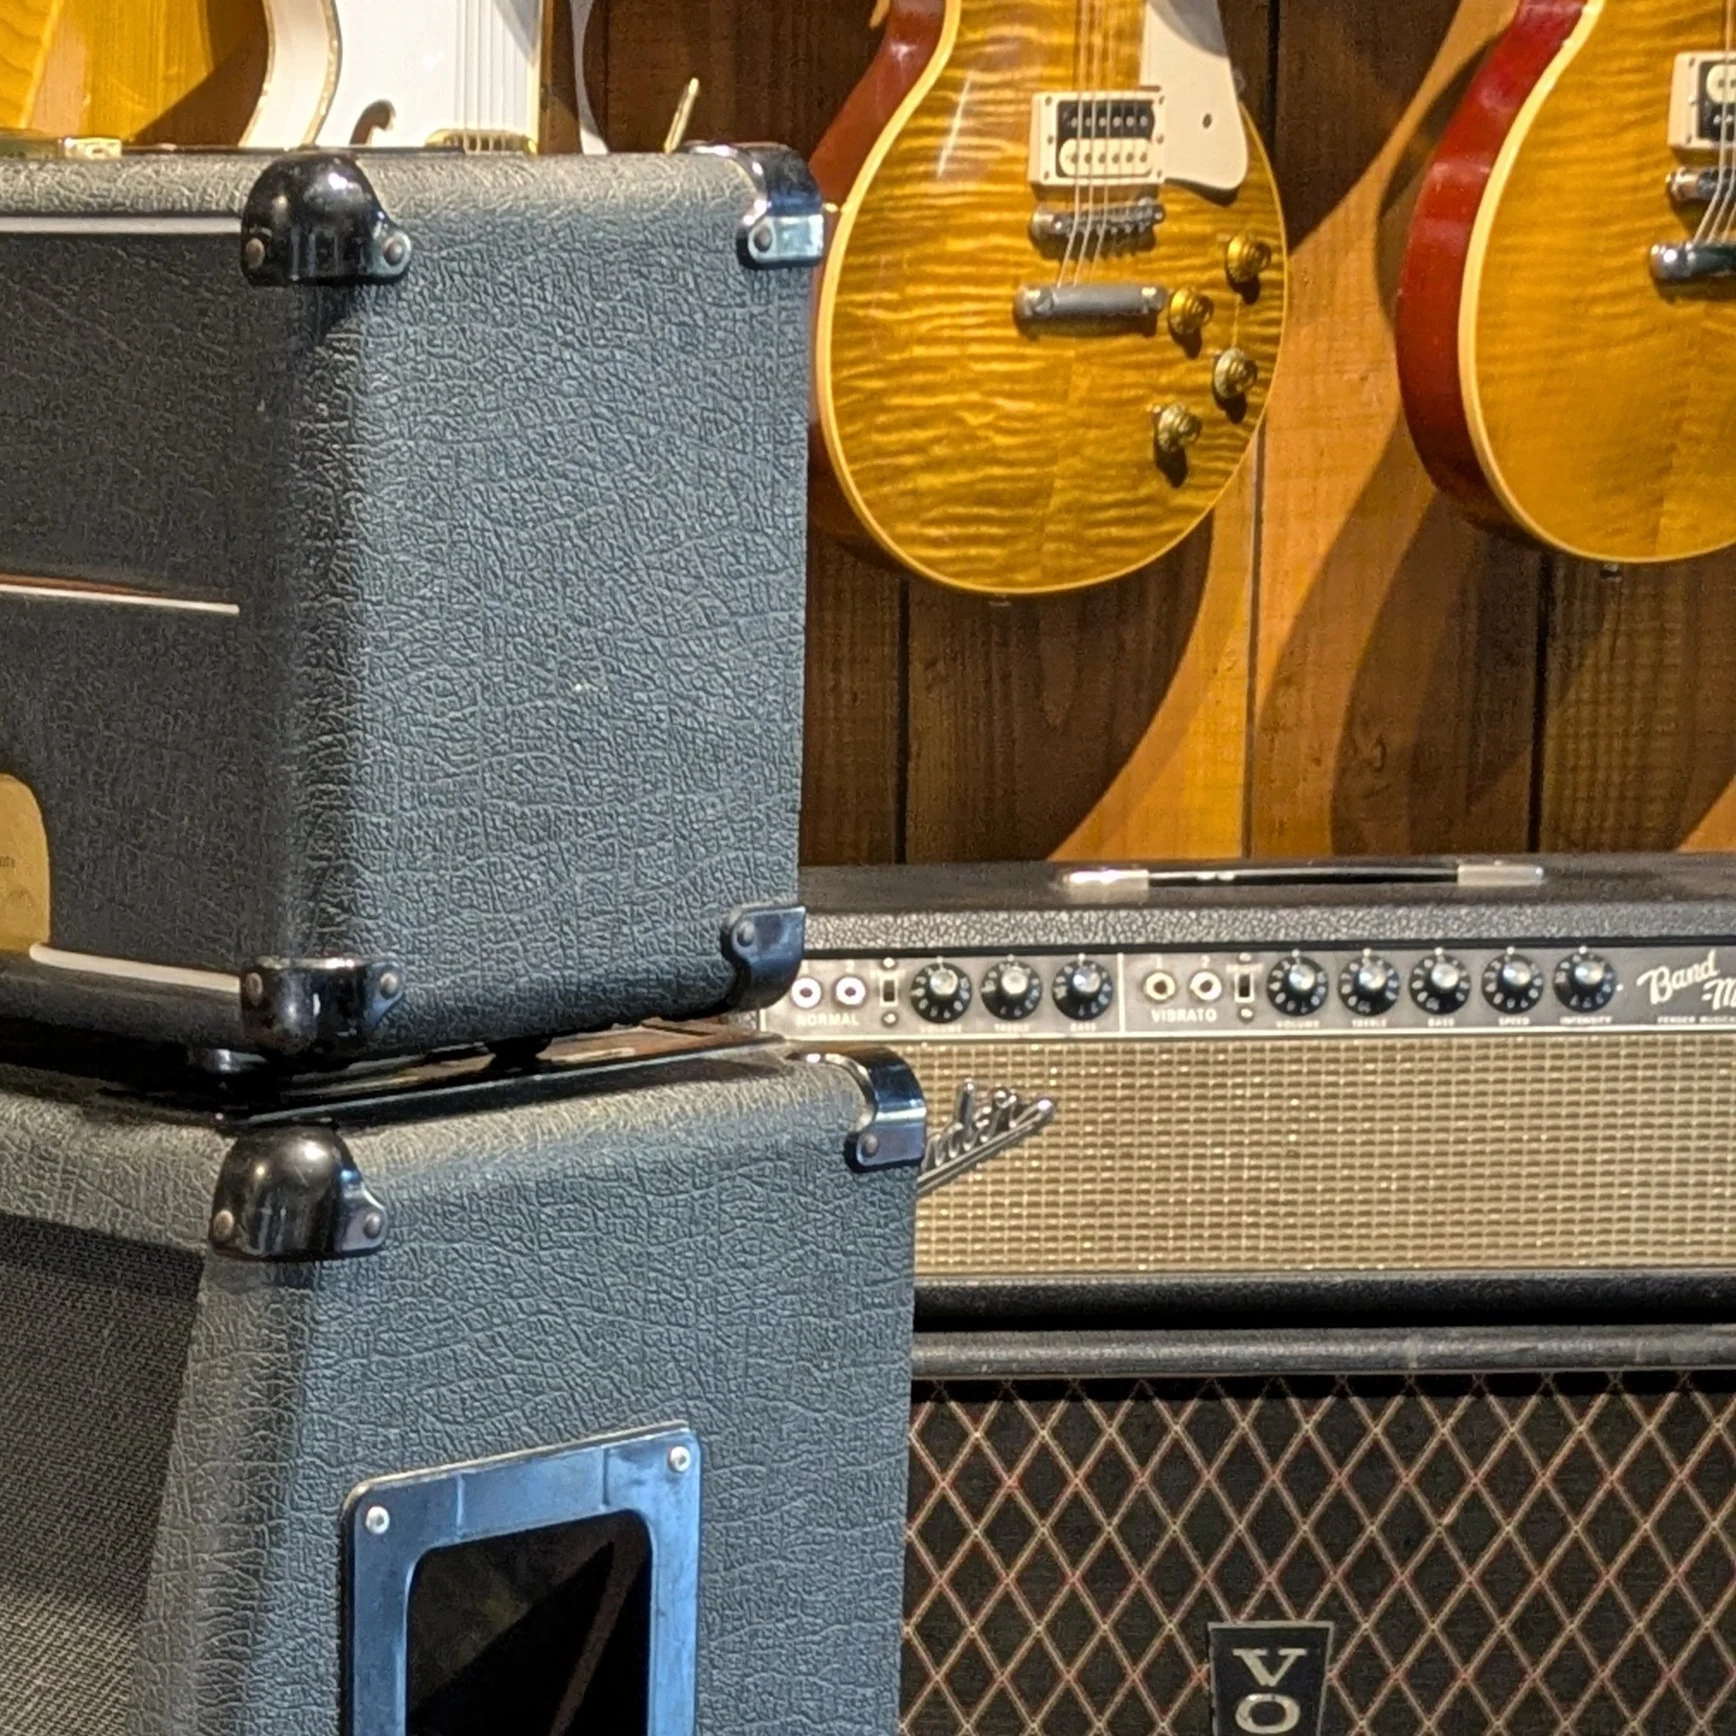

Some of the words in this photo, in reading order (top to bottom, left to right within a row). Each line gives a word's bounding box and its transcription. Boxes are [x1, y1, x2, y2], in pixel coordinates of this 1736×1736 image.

[1636, 949, 1721, 1005] Band
[795, 1013, 861, 1027] NORMAL
[1150, 1008, 1218, 1023] VIBRATO
